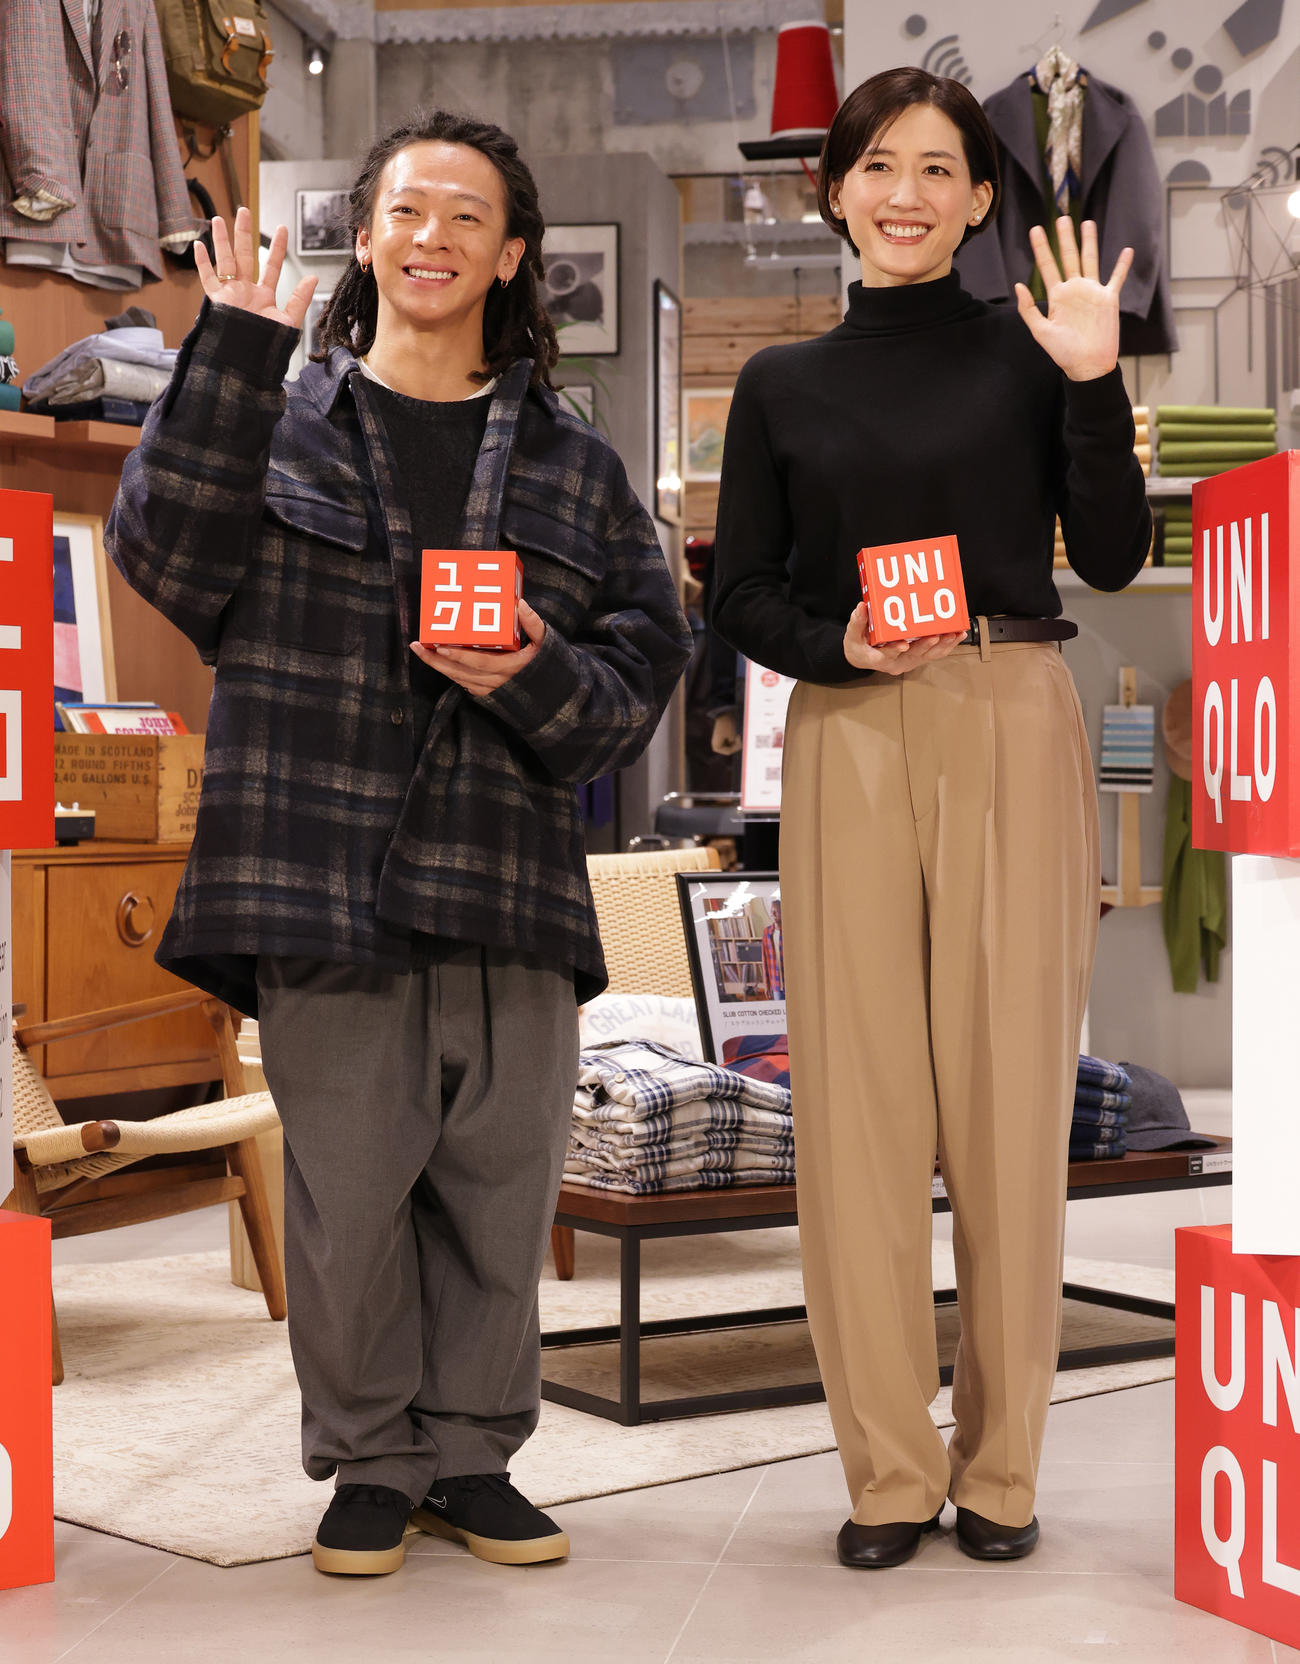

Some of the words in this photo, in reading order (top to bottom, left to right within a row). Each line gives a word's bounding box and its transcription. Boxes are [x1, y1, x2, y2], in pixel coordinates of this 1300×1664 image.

[434, 562, 501, 593] ユニ
[876, 549, 945, 588] UNI
[1203, 512, 1269, 647] UNI
[430, 601, 501, 632] クロ
[883, 588, 957, 632] QLO
[138, 717, 170, 728] JOHN
[71, 759, 106, 770] ROUND
[113, 760, 152, 771] FIFTHS
[85, 745, 96, 755] IN
[101, 745, 154, 757] SCOTLAND
[1203, 675, 1277, 824] QLO
[82, 773, 127, 784] GALLONS
[588, 999, 654, 1035] GREAT
